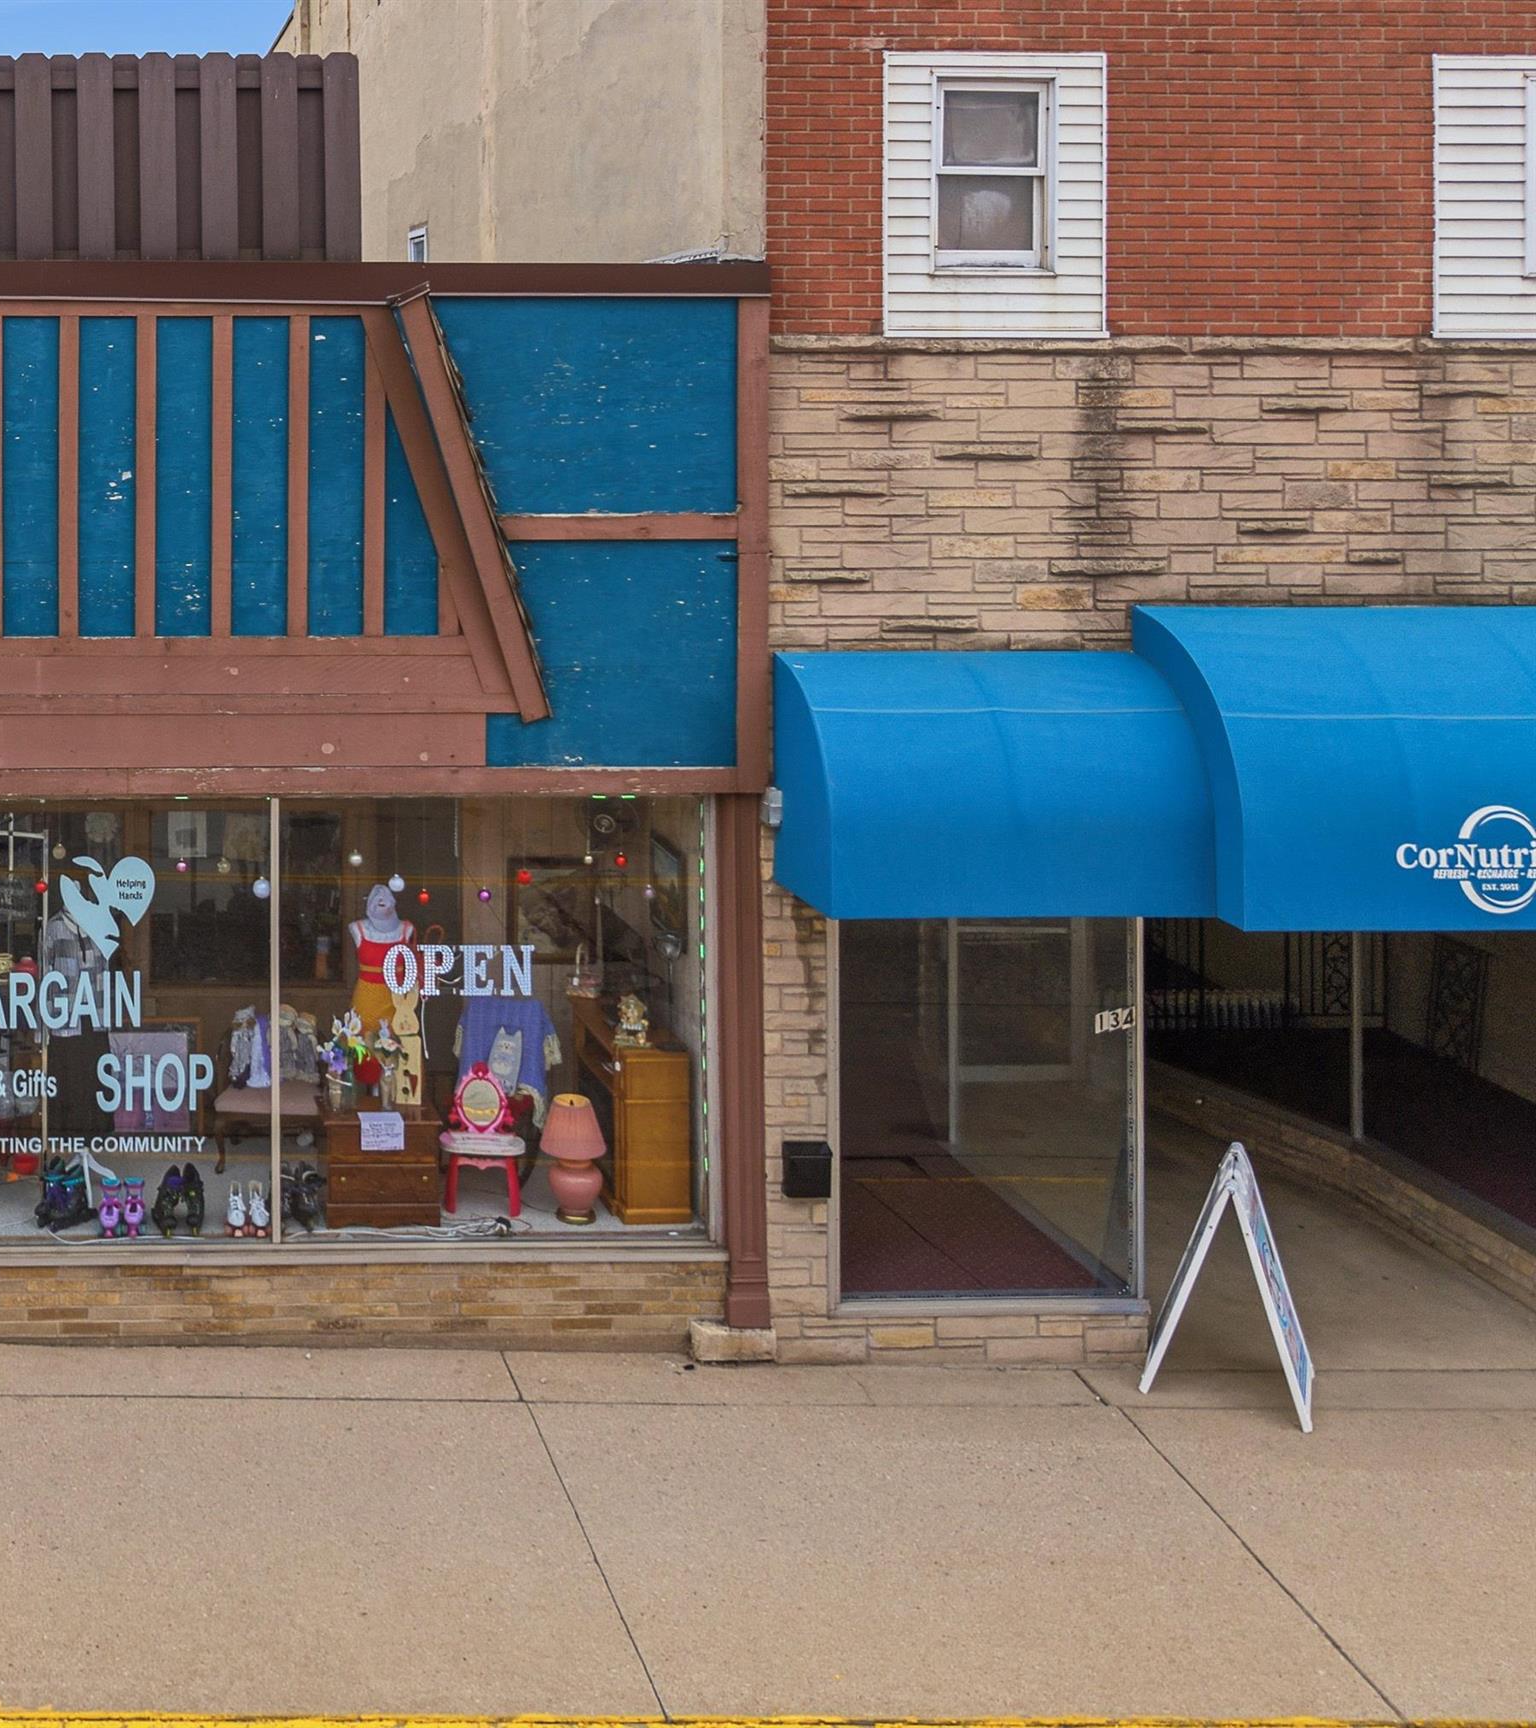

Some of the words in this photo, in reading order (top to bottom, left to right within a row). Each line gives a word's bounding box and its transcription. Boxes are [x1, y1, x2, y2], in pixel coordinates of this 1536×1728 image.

[116, 879, 146, 889] Helping
[119, 891, 143, 900] Hands
[383, 944, 535, 996] OPEN
[1099, 1008, 1134, 1031] 134
[13, 1068, 57, 1098] Gifts
[95, 1053, 214, 1113] SHOP
[48, 1137, 85, 1153] THE
[90, 1136, 206, 1153] COMMUNITY
